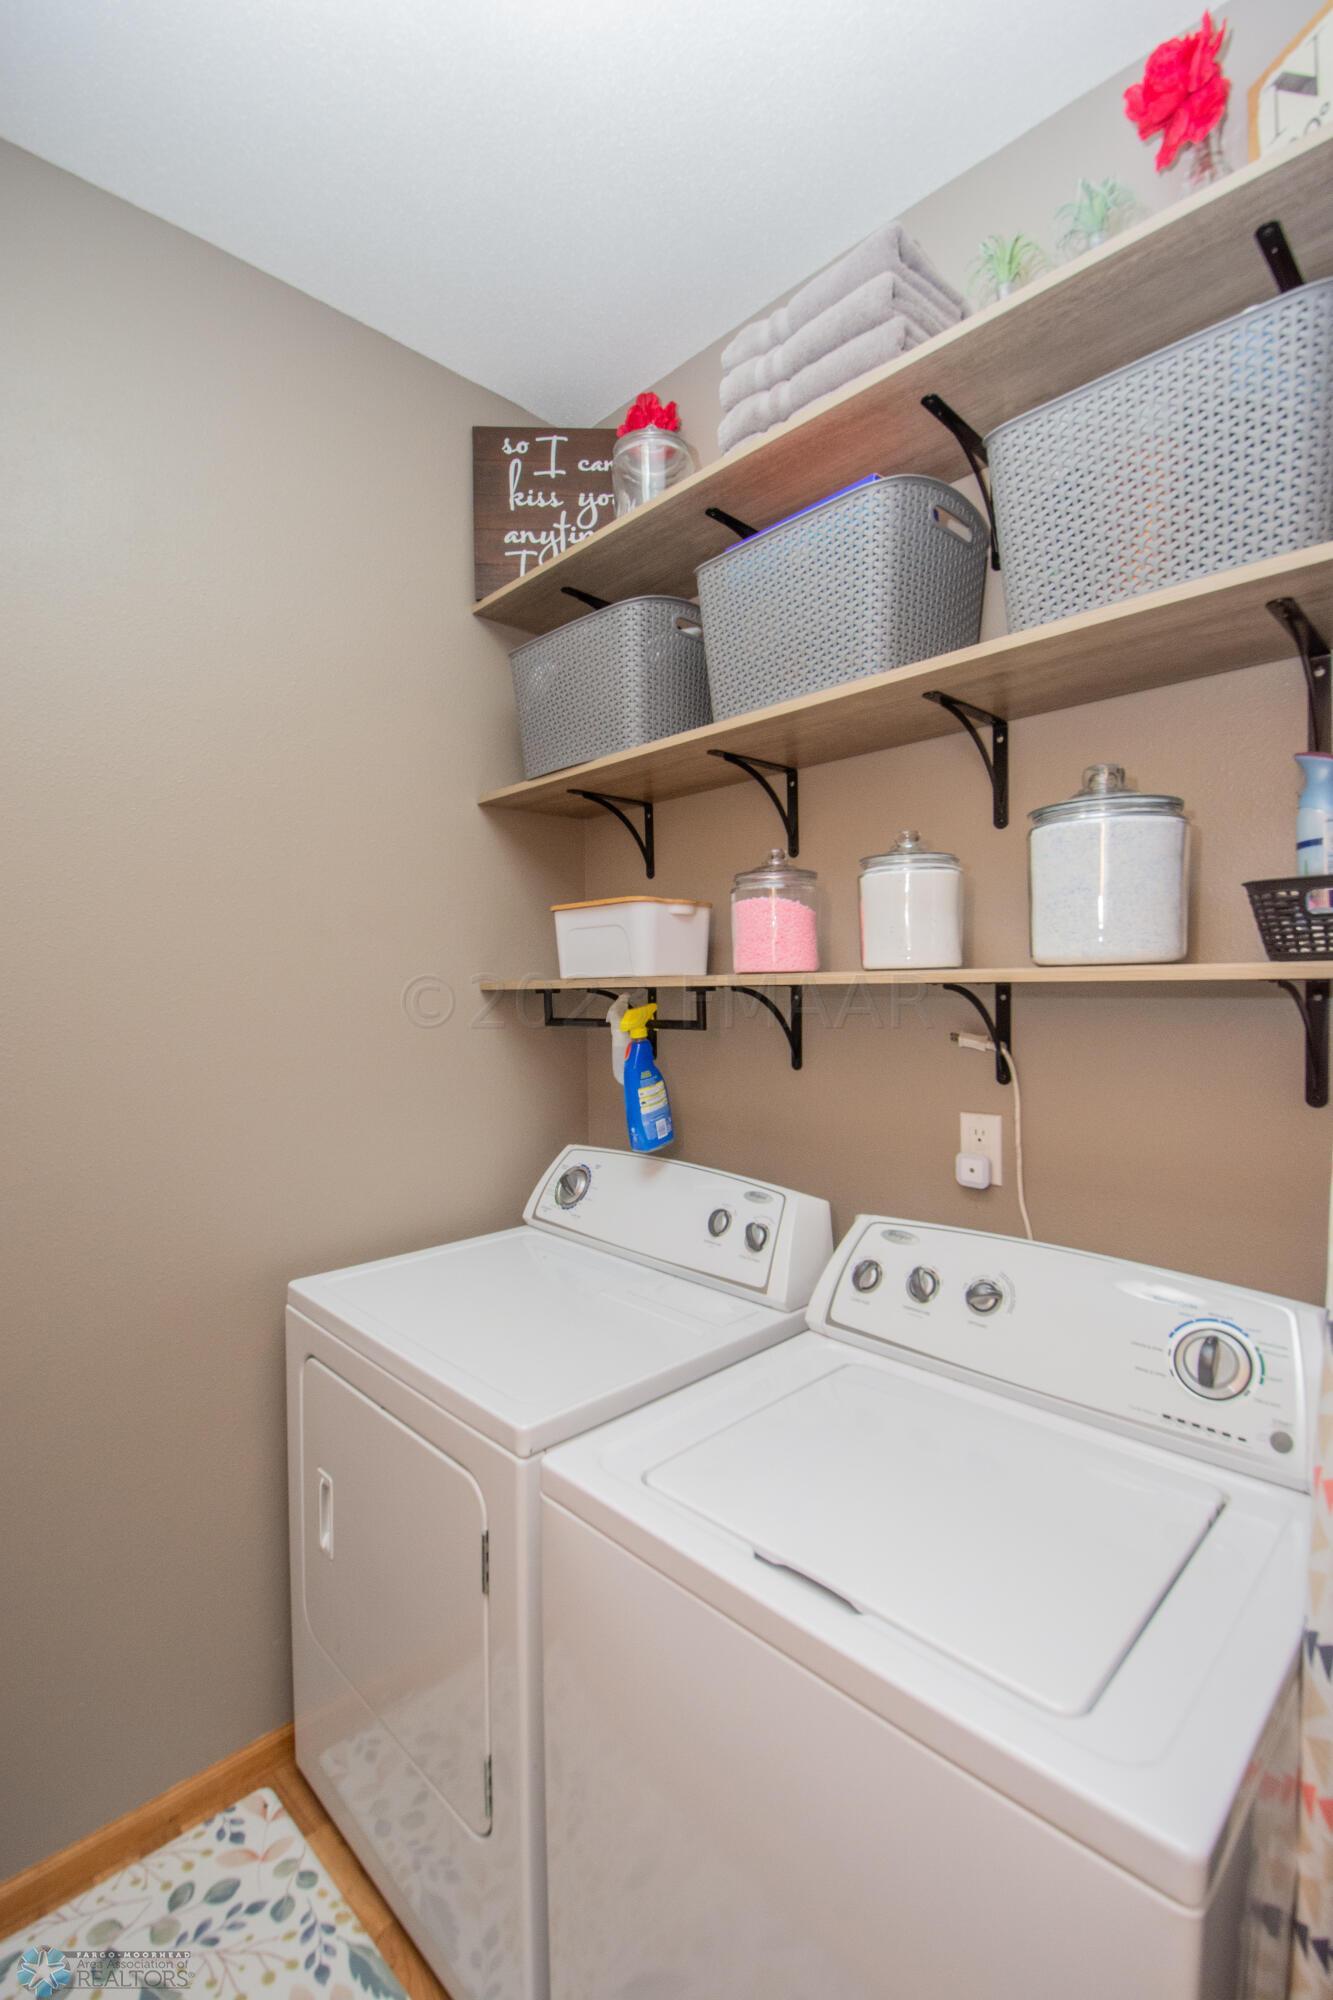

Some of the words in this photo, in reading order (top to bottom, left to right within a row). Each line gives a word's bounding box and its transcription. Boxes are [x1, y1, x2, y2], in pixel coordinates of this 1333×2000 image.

[501, 437, 530, 455] so
[533, 435, 569, 479] I
[508, 458, 564, 511] kiss
[576, 491, 615, 530] yo
